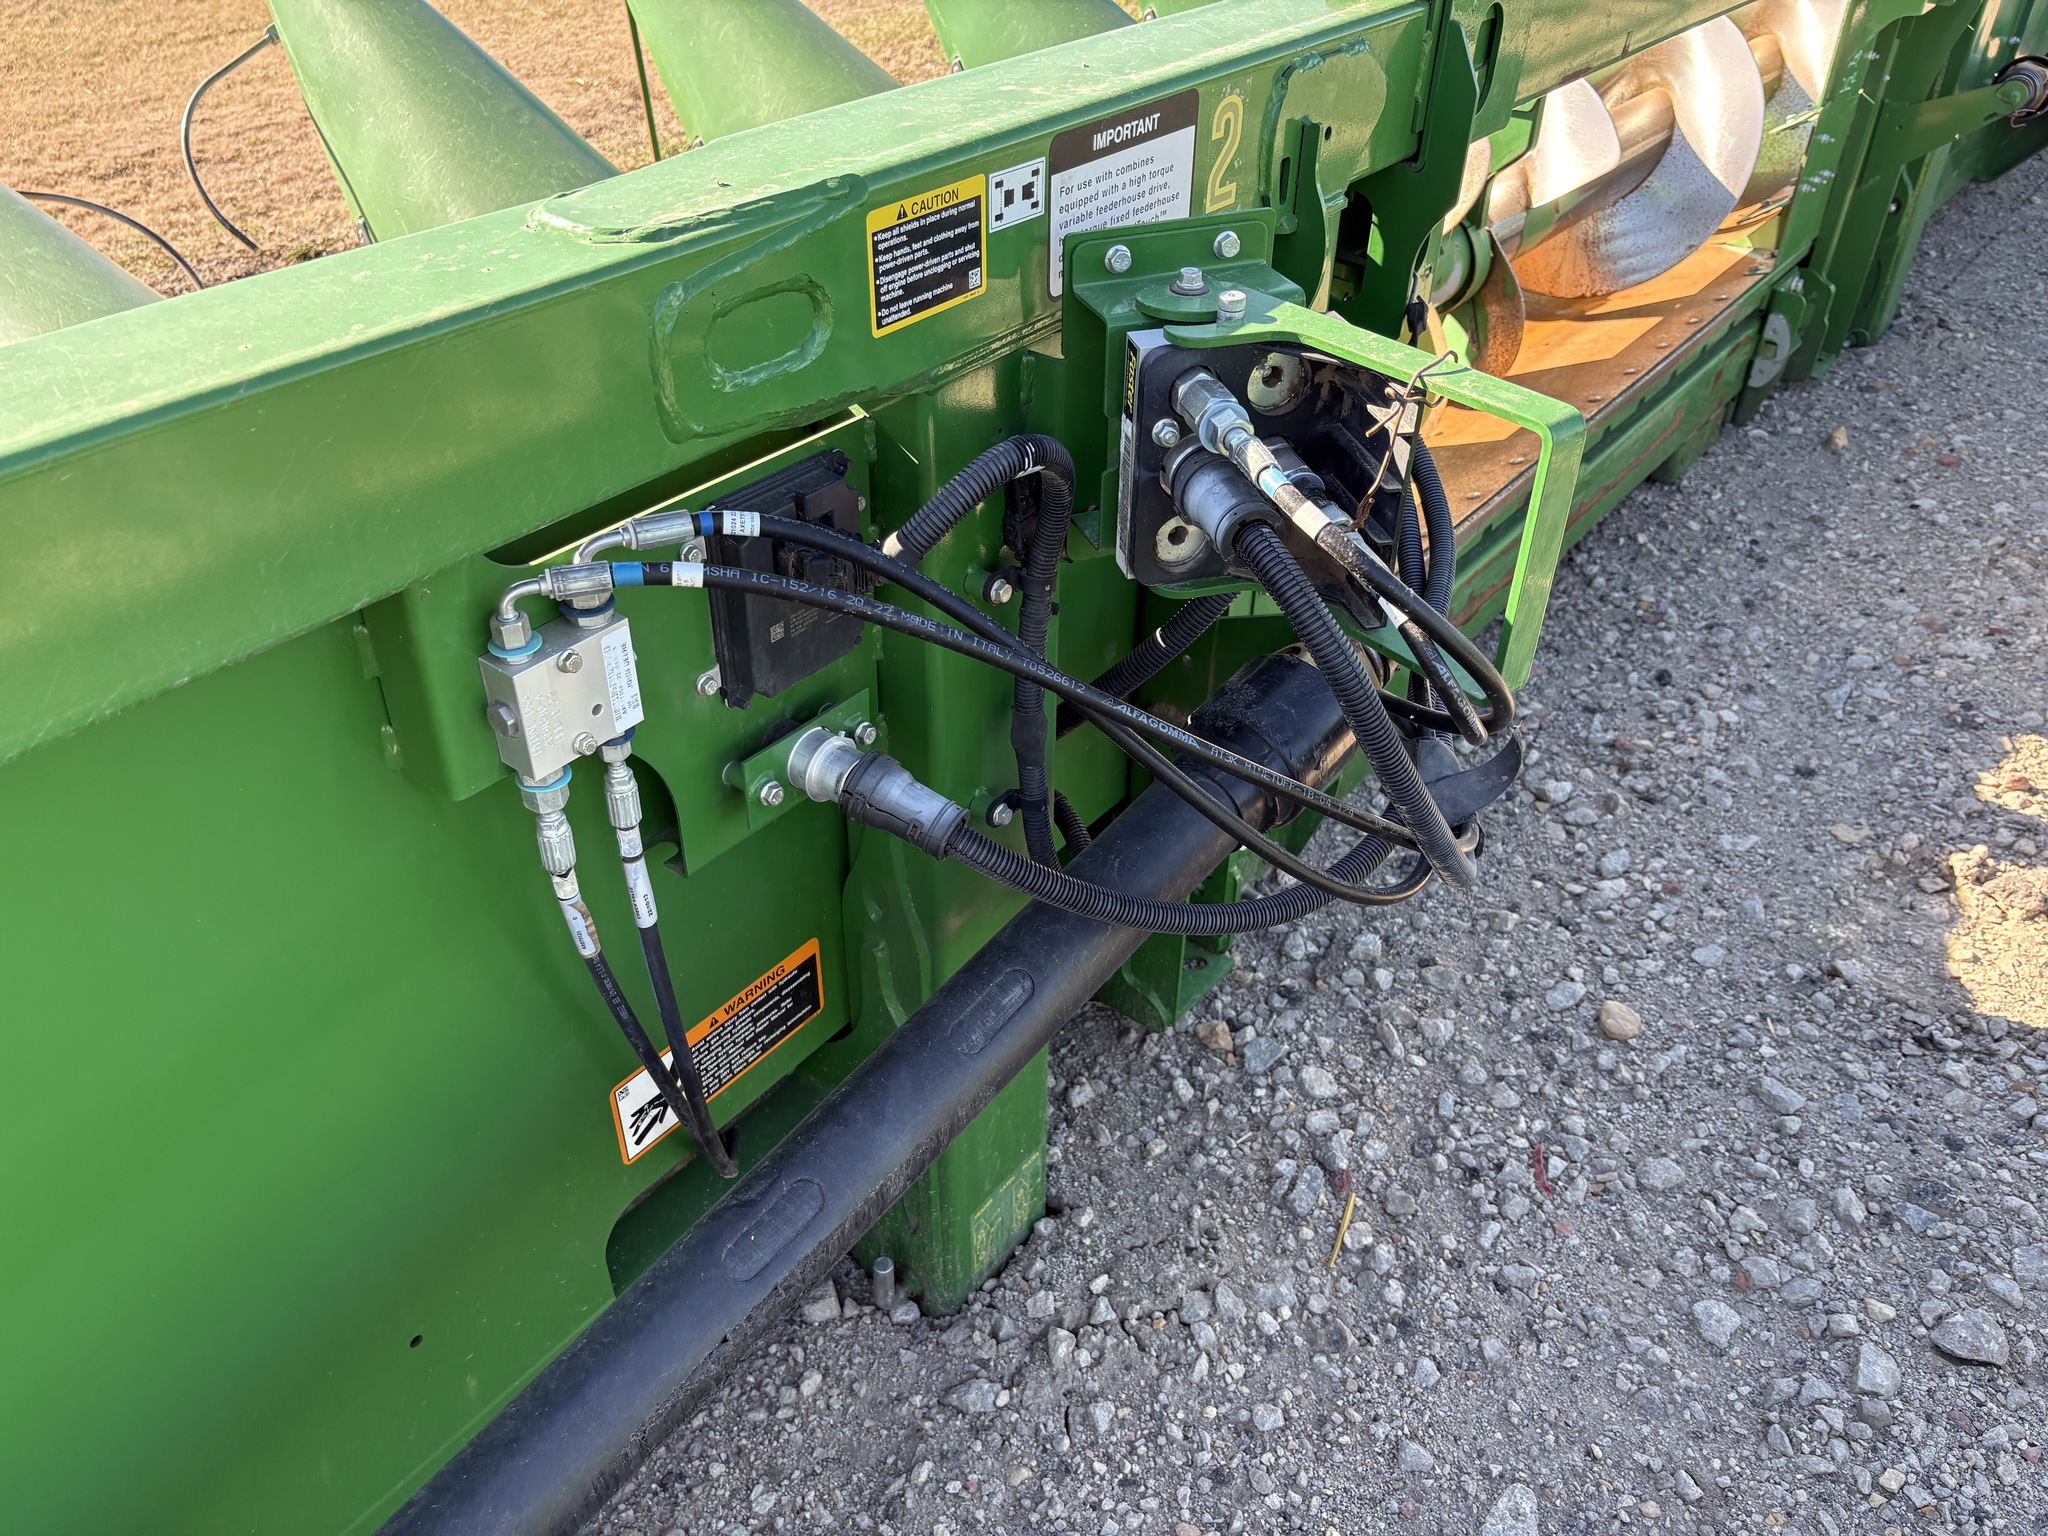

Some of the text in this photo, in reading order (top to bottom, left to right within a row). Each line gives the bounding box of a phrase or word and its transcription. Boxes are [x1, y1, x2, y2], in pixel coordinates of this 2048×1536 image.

[1093, 113, 1160, 151] IMPORTANT
[1205, 95, 1243, 214] 2
[1059, 156, 1154, 198] For use with combines
[1059, 164, 1174, 216] equipped with a high torque
[911, 188, 958, 215] CAUTION
[1059, 181, 1170, 230] variable feederhouse drive,
[1110, 211, 1129, 225] fixed
[1133, 192, 1180, 216] feederhouse
[878, 231, 891, 241] Keep
[900, 221, 919, 233] shields
[926, 214, 940, 225] place
[941, 207, 957, 218] during
[958, 200, 975, 212] normal
[878, 235, 908, 251] operations.
[879, 221, 979, 262] Keep hands, feet and clothing away from
[879, 249, 929, 273] power-driven parts.
[880, 242, 975, 285] Disengage power-driven parts and shut
[888, 278, 906, 290] engine
[907, 272, 923, 283] before
[924, 261, 951, 276] unclogging
[958, 250, 979, 263] servicing
[881, 289, 904, 302] machine.
[890, 304, 898, 313] not
[899, 299, 912, 309] leave
[913, 291, 932, 304] running
[933, 283, 953, 295] machine
[882, 308, 911, 325] unattended.
[660, 564, 670, 573] 6
[751, 572, 837, 599] IC-152/16
[874, 604, 895, 616] 22
[900, 611, 937, 633] MADE
[947, 626, 964, 642] IN
[971, 636, 1013, 661] ITALY
[1022, 658, 1087, 694] T0526612
[1111, 705, 1201, 749] ALFAGOMMA
[522, 693, 533, 718] USA
[724, 965, 785, 1015] WARNING
[692, 1040, 704, 1052] Avoid
[706, 1027, 723, 1041] serious
[724, 1016, 737, 1027] injury
[768, 985, 777, 993] with
[779, 970, 797, 985] hydraulic
[700, 1043, 709, 1052] and
[711, 1036, 719, 1044] gas
[721, 1024, 733, 1036] under
[710, 1033, 730, 1051] removing
[732, 1017, 752, 1034] hydraulic
[718, 1043, 734, 1056] system
[735, 1026, 755, 1043] hydraulic
[746, 1032, 754, 1041] and
[720, 1069, 730, 1078] DRY
[731, 1055, 740, 1064] and
[721, 1073, 732, 1084] John
